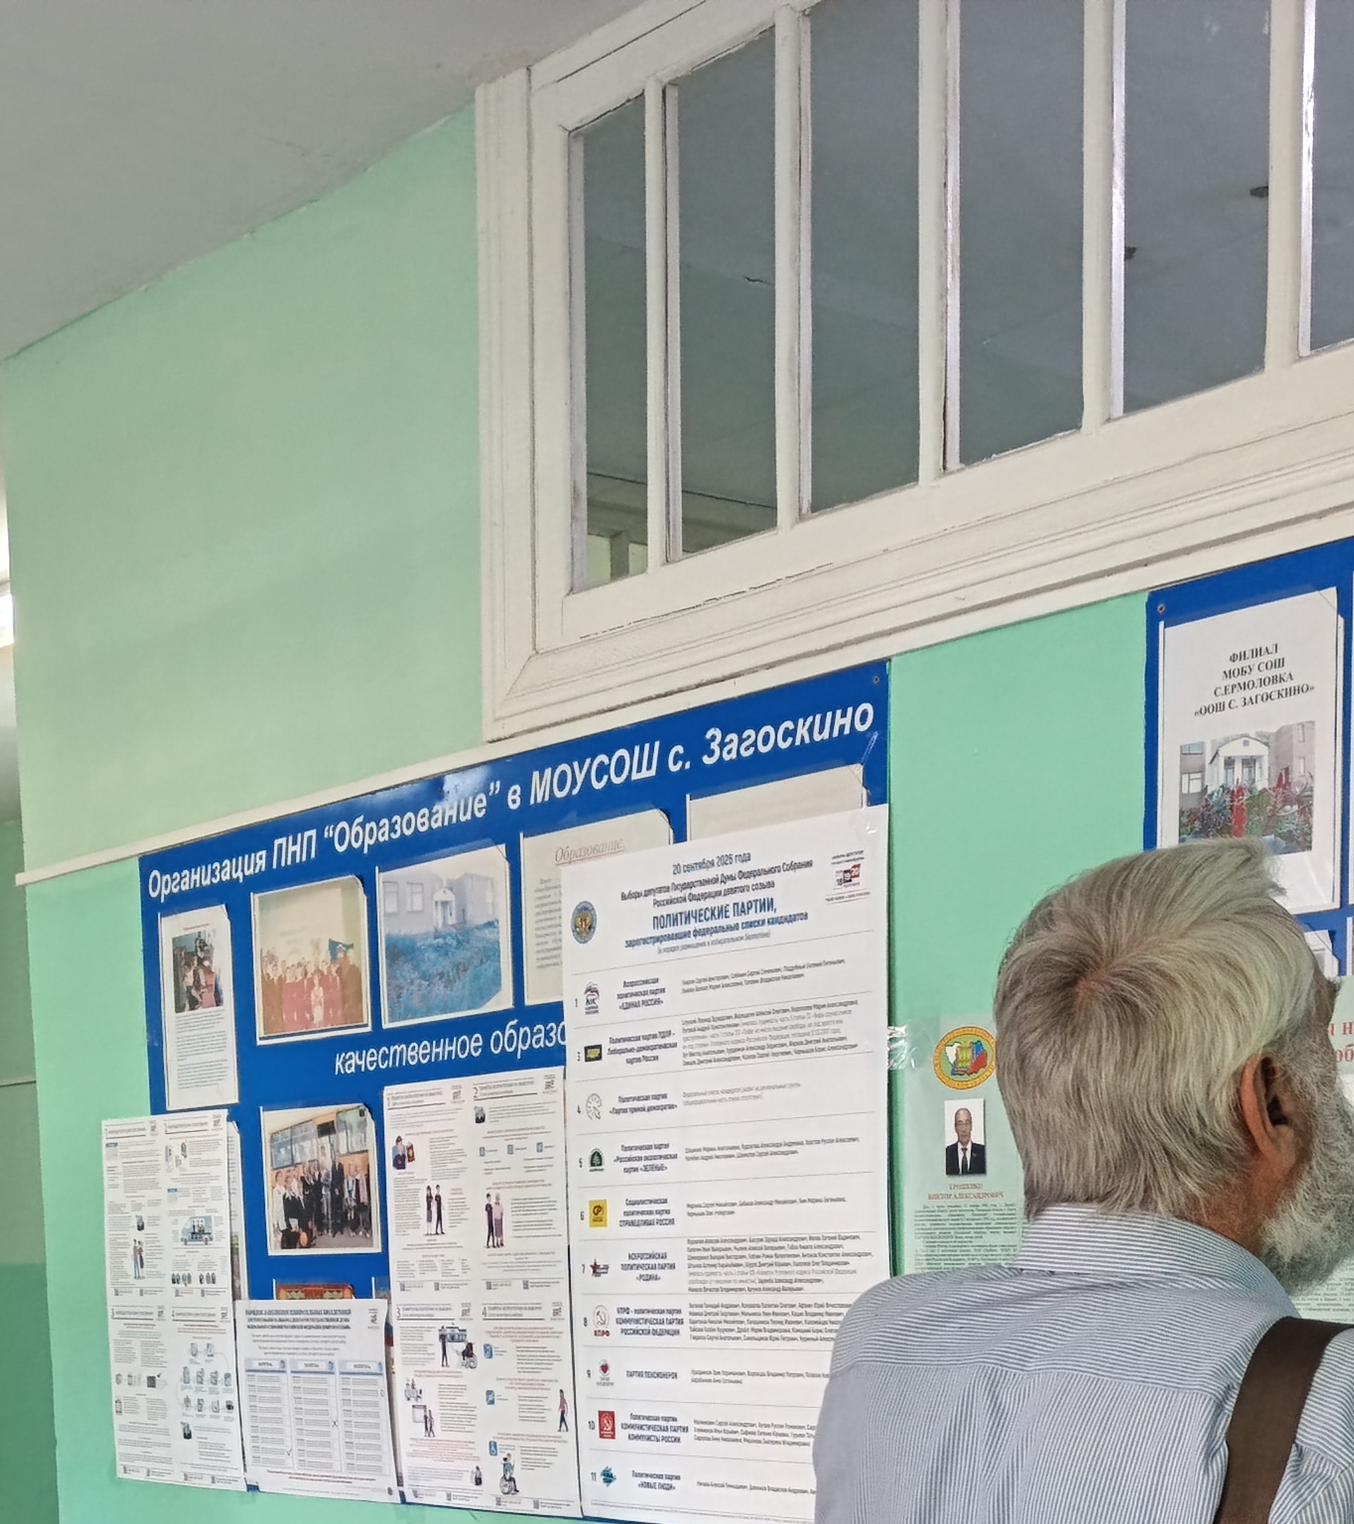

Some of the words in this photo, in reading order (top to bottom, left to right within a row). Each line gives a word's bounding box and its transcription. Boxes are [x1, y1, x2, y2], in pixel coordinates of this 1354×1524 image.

[1222, 663, 1255, 680] МОБУ
[1257, 657, 1285, 673] СОШ
[1229, 642, 1279, 663] ФИЛИАЛ
[1194, 700, 1225, 717] «ООШ
[1241, 683, 1315, 707] ЗАГОСКИНО»
[148, 850, 266, 903] Организация
[273, 830, 316, 869] ПНП
[508, 787, 520, 810] в
[530, 741, 660, 806] МОУСОШ
[668, 744, 691, 772] с.
[703, 702, 875, 766] Загоскино
[672, 863, 682, 875] 20
[652, 903, 731, 930] ПОЛИТИЧЕСКИЕ
[732, 896, 777, 917] ПАРТИИ,
[335, 1032, 483, 1075] качественное
